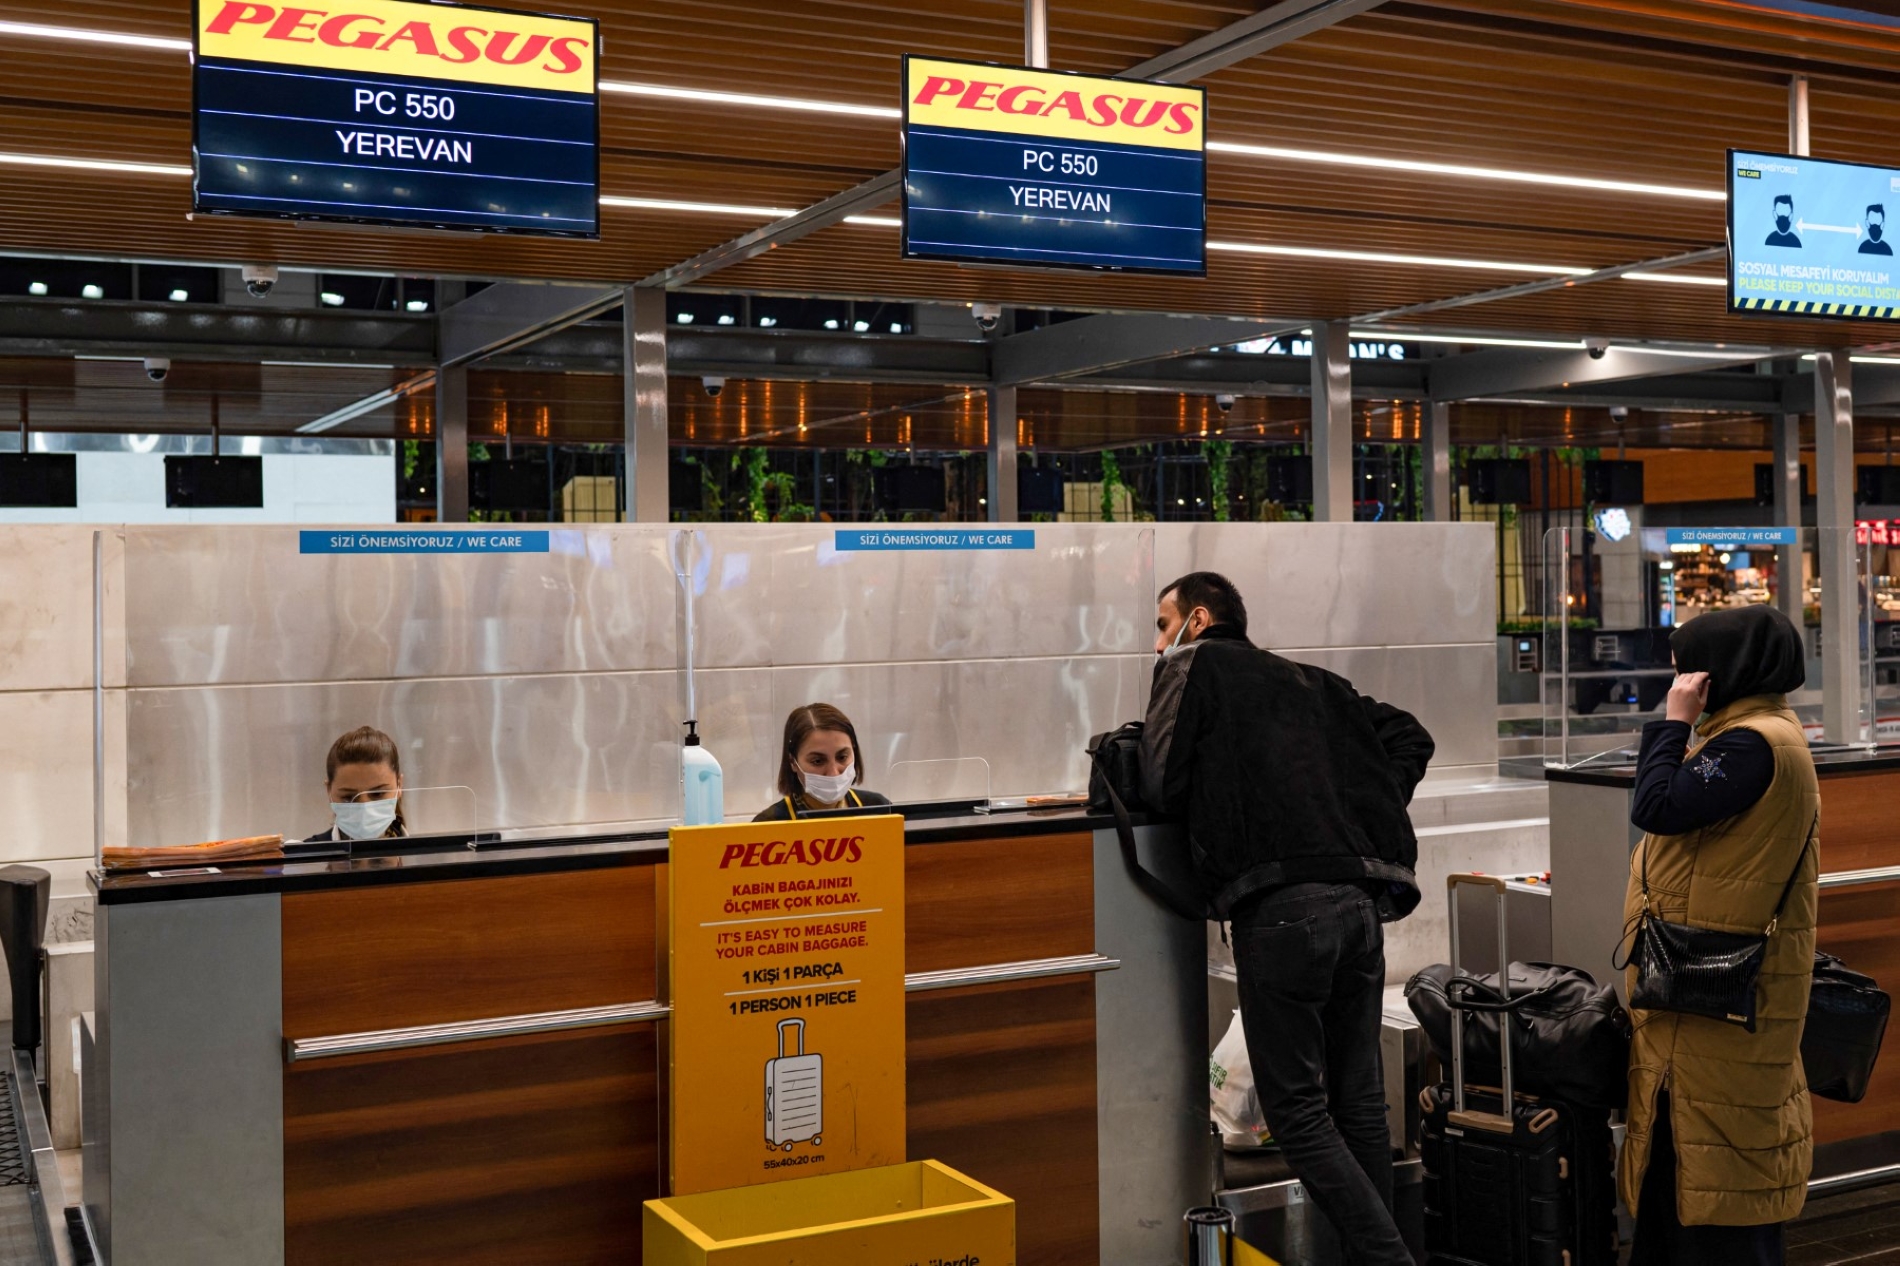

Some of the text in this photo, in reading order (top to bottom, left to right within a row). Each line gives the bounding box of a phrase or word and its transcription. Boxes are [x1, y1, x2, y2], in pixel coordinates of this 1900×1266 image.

[205, 0, 590, 74] PEGASUS
[354, 88, 456, 121] PC 550
[913, 75, 1199, 135] PEGASUS
[335, 130, 473, 164] YEREVAN
[1023, 149, 1099, 176] PC 550
[1008, 185, 1112, 212] YEREVAN
[1739, 262, 1889, 285] SOSYAL MESAFEYİ KORUYALIM
[1739, 277, 1777, 292] PLEASE
[1779, 281, 1803, 294] KEEP
[1806, 282, 1834, 296] YOUR
[1836, 284, 1873, 298] SOCIAL
[330, 534, 354, 548] SİZİ
[358, 534, 454, 548] ÖNEMSİYORUZ
[467, 536, 486, 548] WE
[490, 536, 522, 548] CARE
[860, 533, 879, 545] SİZİ
[882, 533, 959, 545] ÖNEMSİYORUZ
[968, 535, 985, 545] WE
[987, 535, 1013, 545] CARE
[1753, 532, 1763, 540] WE
[1764, 532, 1782, 540] CARE
[719, 836, 865, 869] PEGASUS
[778, 876, 853, 893] BAGAJINIZI
[724, 892, 861, 914] ÖLÇMEK ÇOK KOLAY.
[717, 920, 867, 944] IT'S EASY TO MEASURE
[715, 935, 869, 960] YOUR CABIN BAGGAGE.
[742, 971, 750, 984] 1
[783, 967, 791, 980] 1
[793, 962, 844, 980] PARÇA
[729, 990, 857, 1015] 1 PERSON 1 PIECE
[763, 1154, 825, 1170] 55x40x20 cm
